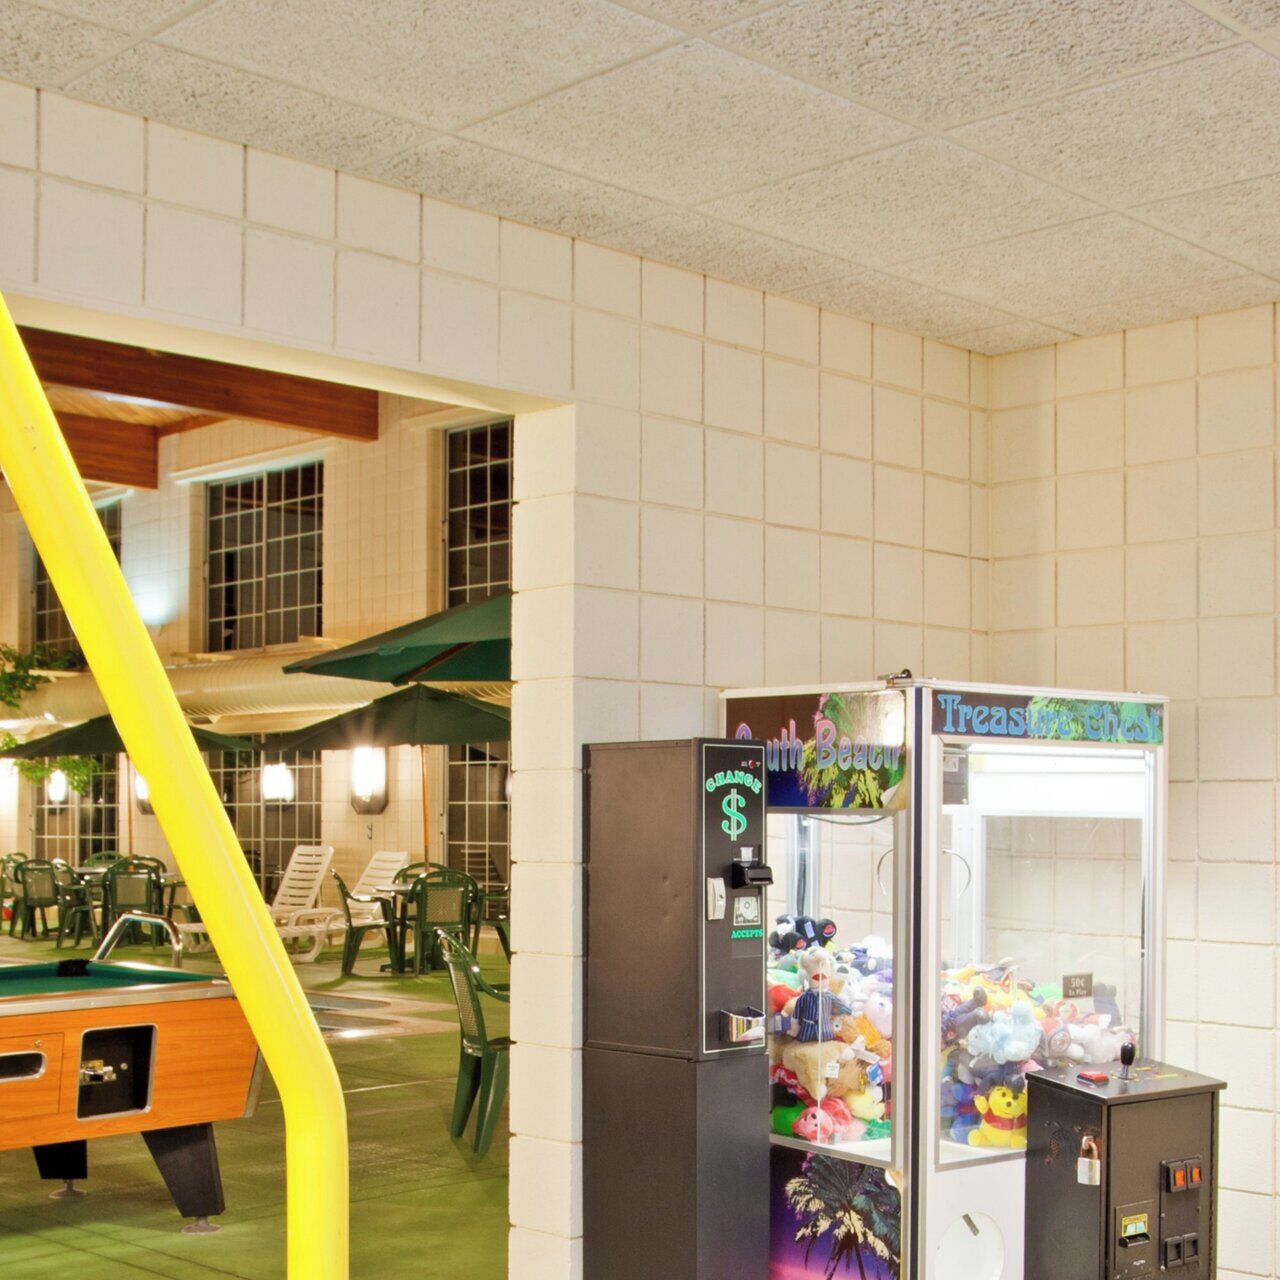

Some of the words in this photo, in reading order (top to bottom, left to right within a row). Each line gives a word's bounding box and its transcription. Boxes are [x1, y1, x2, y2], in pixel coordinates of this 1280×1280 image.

[936, 693, 1074, 736] Treasure
[1082, 702, 1161, 743] Chest
[735, 717, 804, 772] uth
[705, 769, 762, 794] CHANGE
[721, 788, 748, 842] $
[731, 928, 764, 939] ACCEPTS
